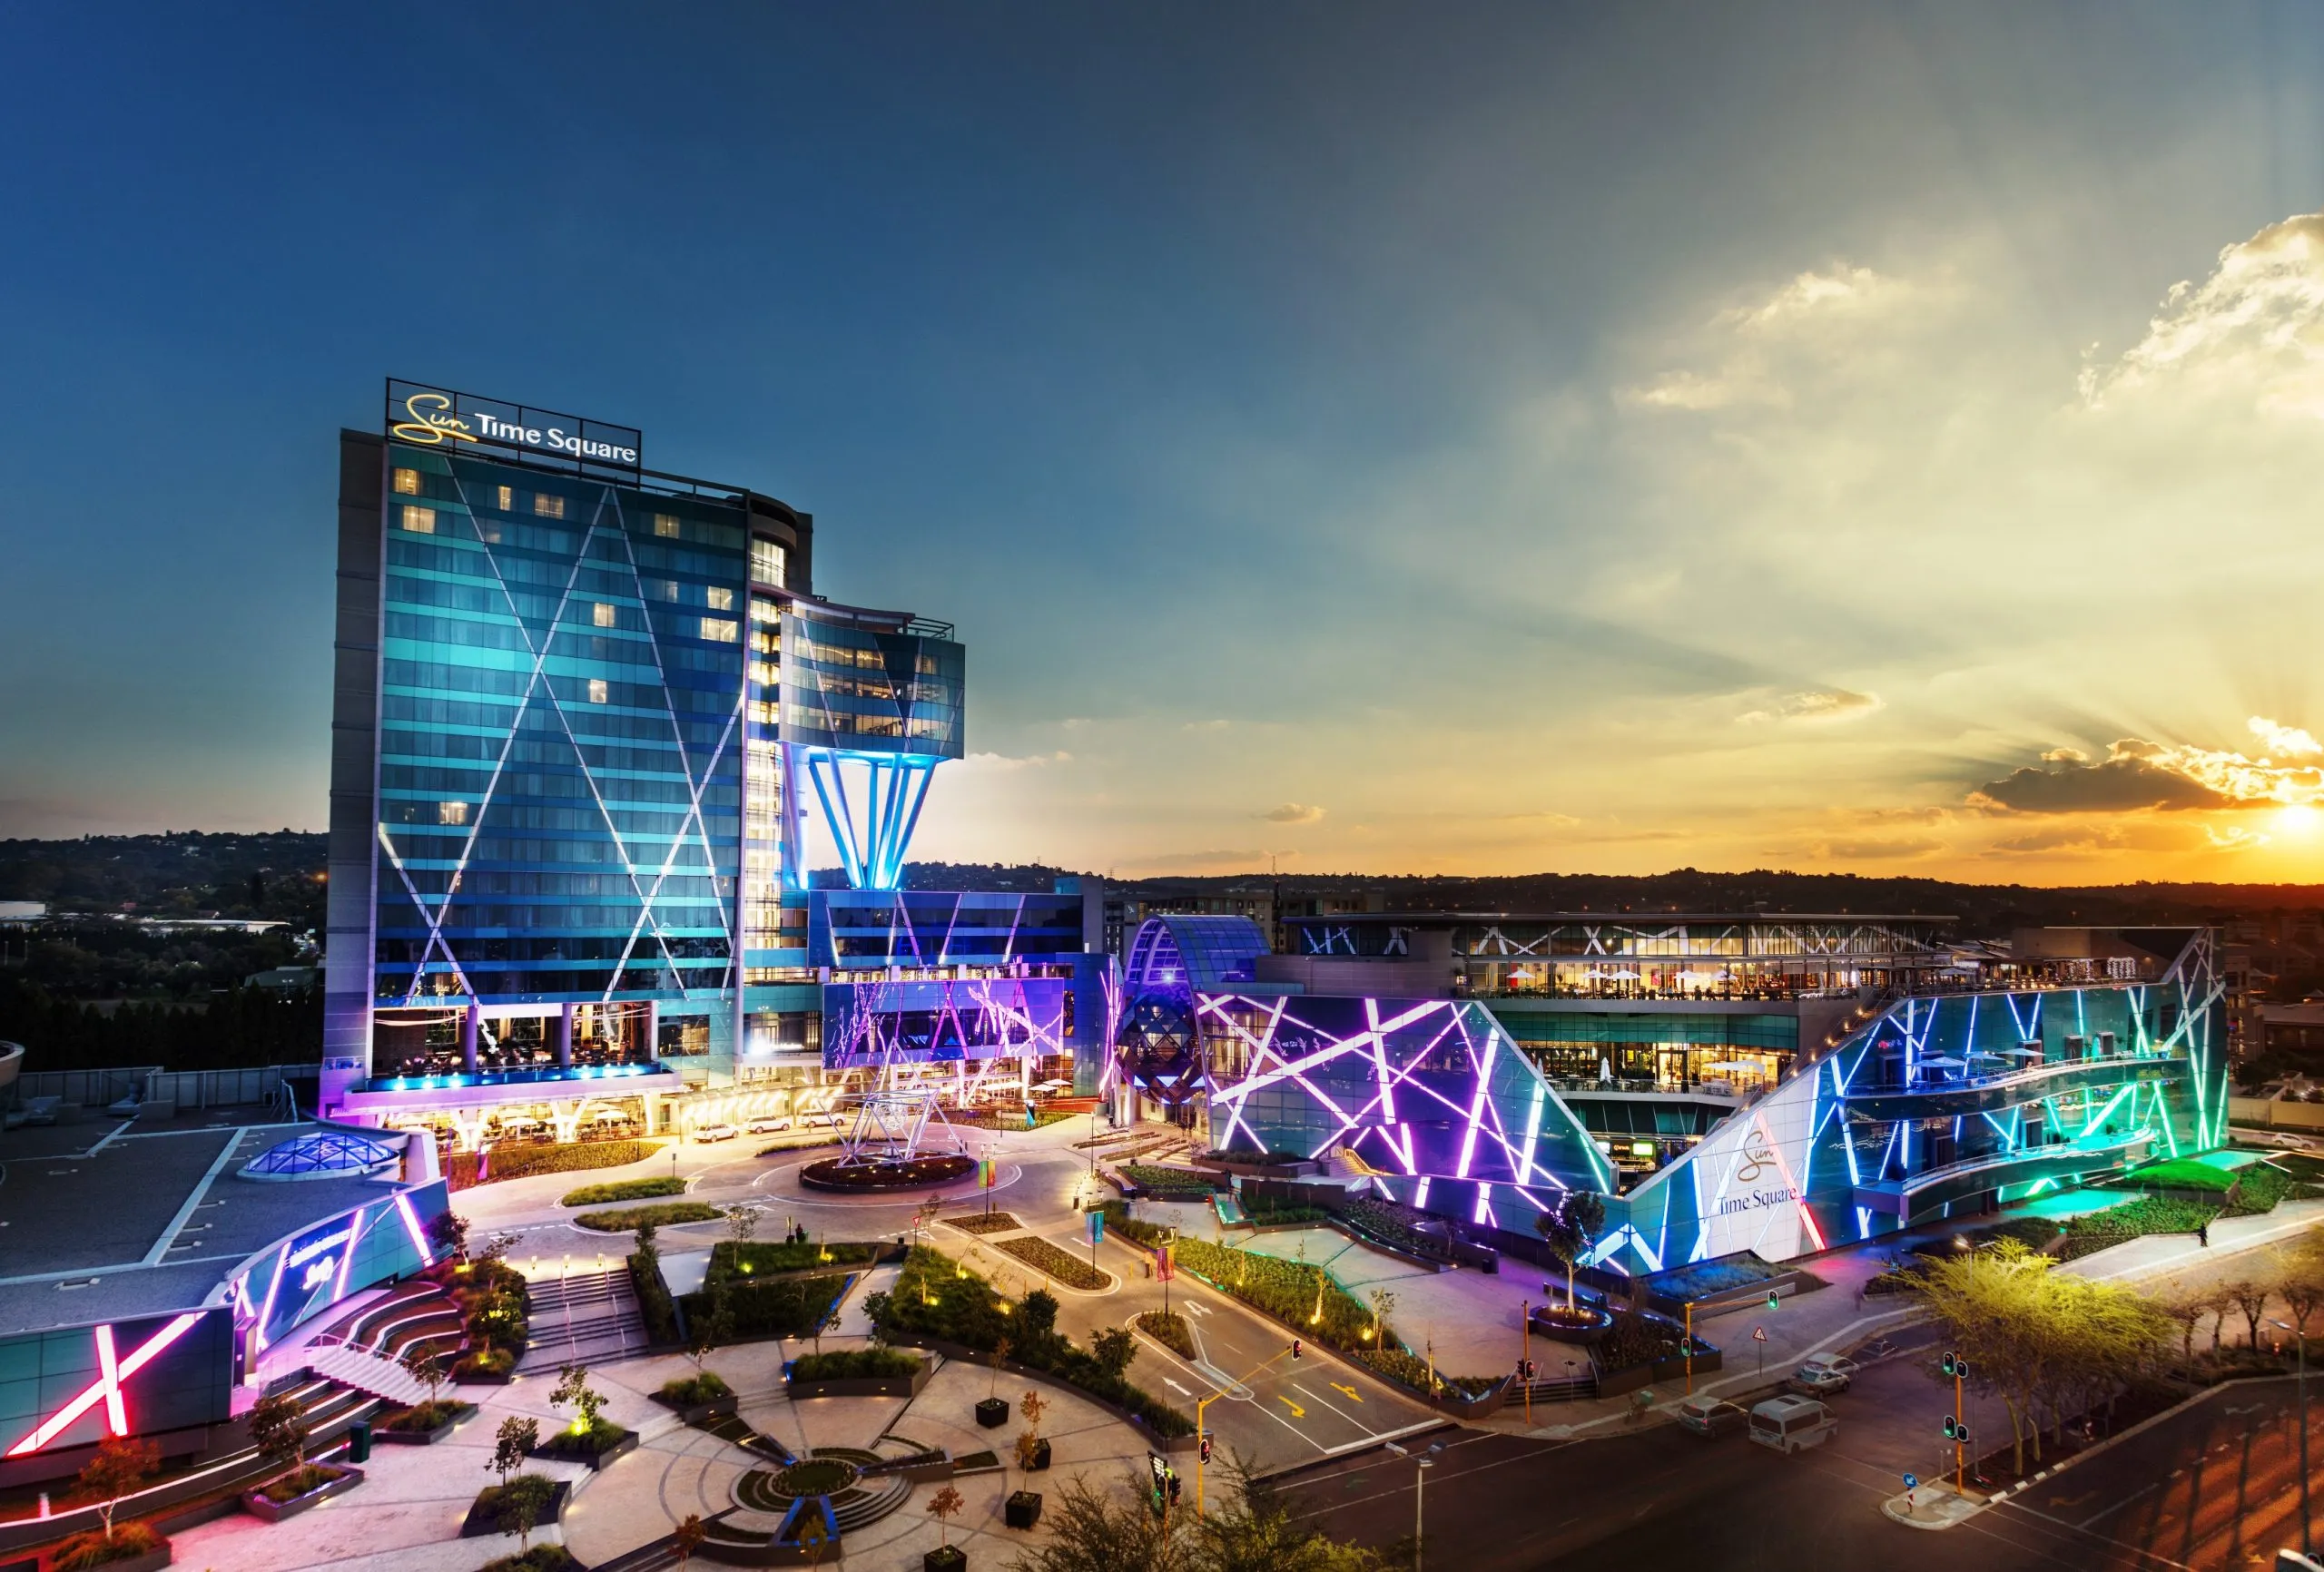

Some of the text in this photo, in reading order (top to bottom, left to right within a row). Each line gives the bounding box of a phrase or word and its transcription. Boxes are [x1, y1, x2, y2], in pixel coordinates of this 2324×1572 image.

[393, 394, 636, 463] Sun Time Square
[1738, 1131, 1777, 1182] Sun
[1718, 1187, 1797, 1215] Time Square
